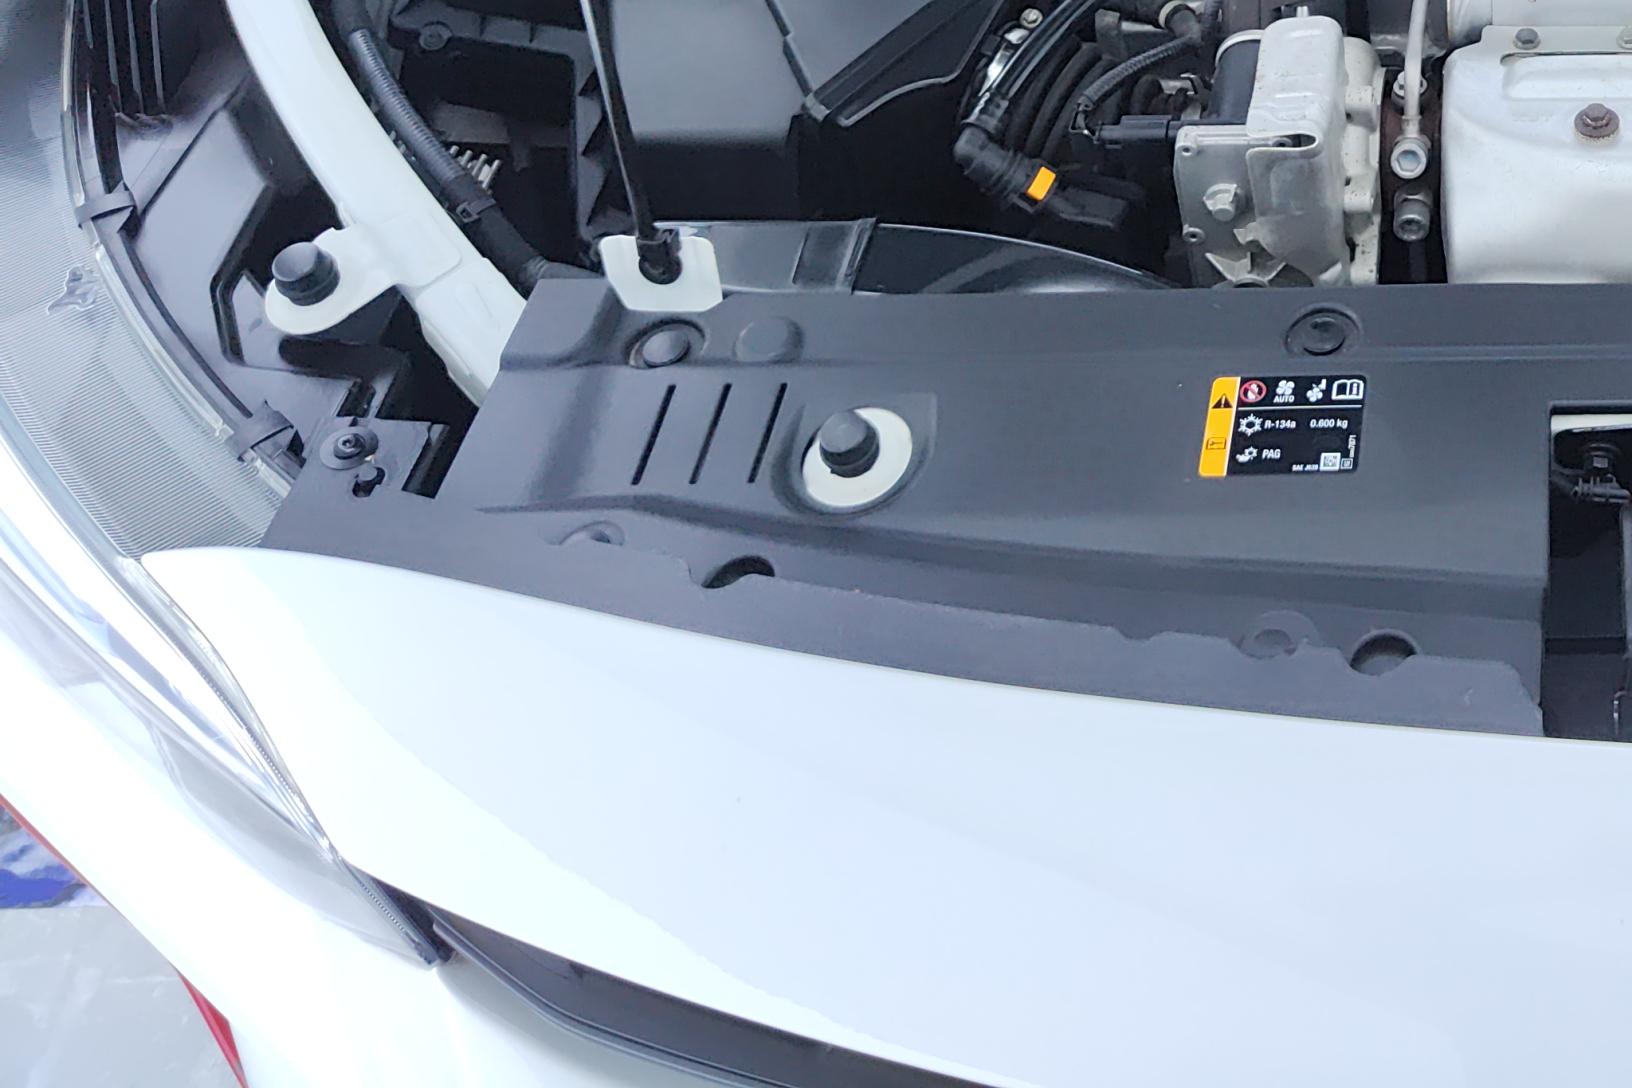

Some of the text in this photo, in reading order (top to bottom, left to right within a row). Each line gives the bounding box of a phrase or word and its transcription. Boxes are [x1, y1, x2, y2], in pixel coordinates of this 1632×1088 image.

[1273, 395, 1295, 403] AUTO
[1264, 418, 1348, 430] R-134a 0.600 kg
[1262, 448, 1281, 460] PAG
